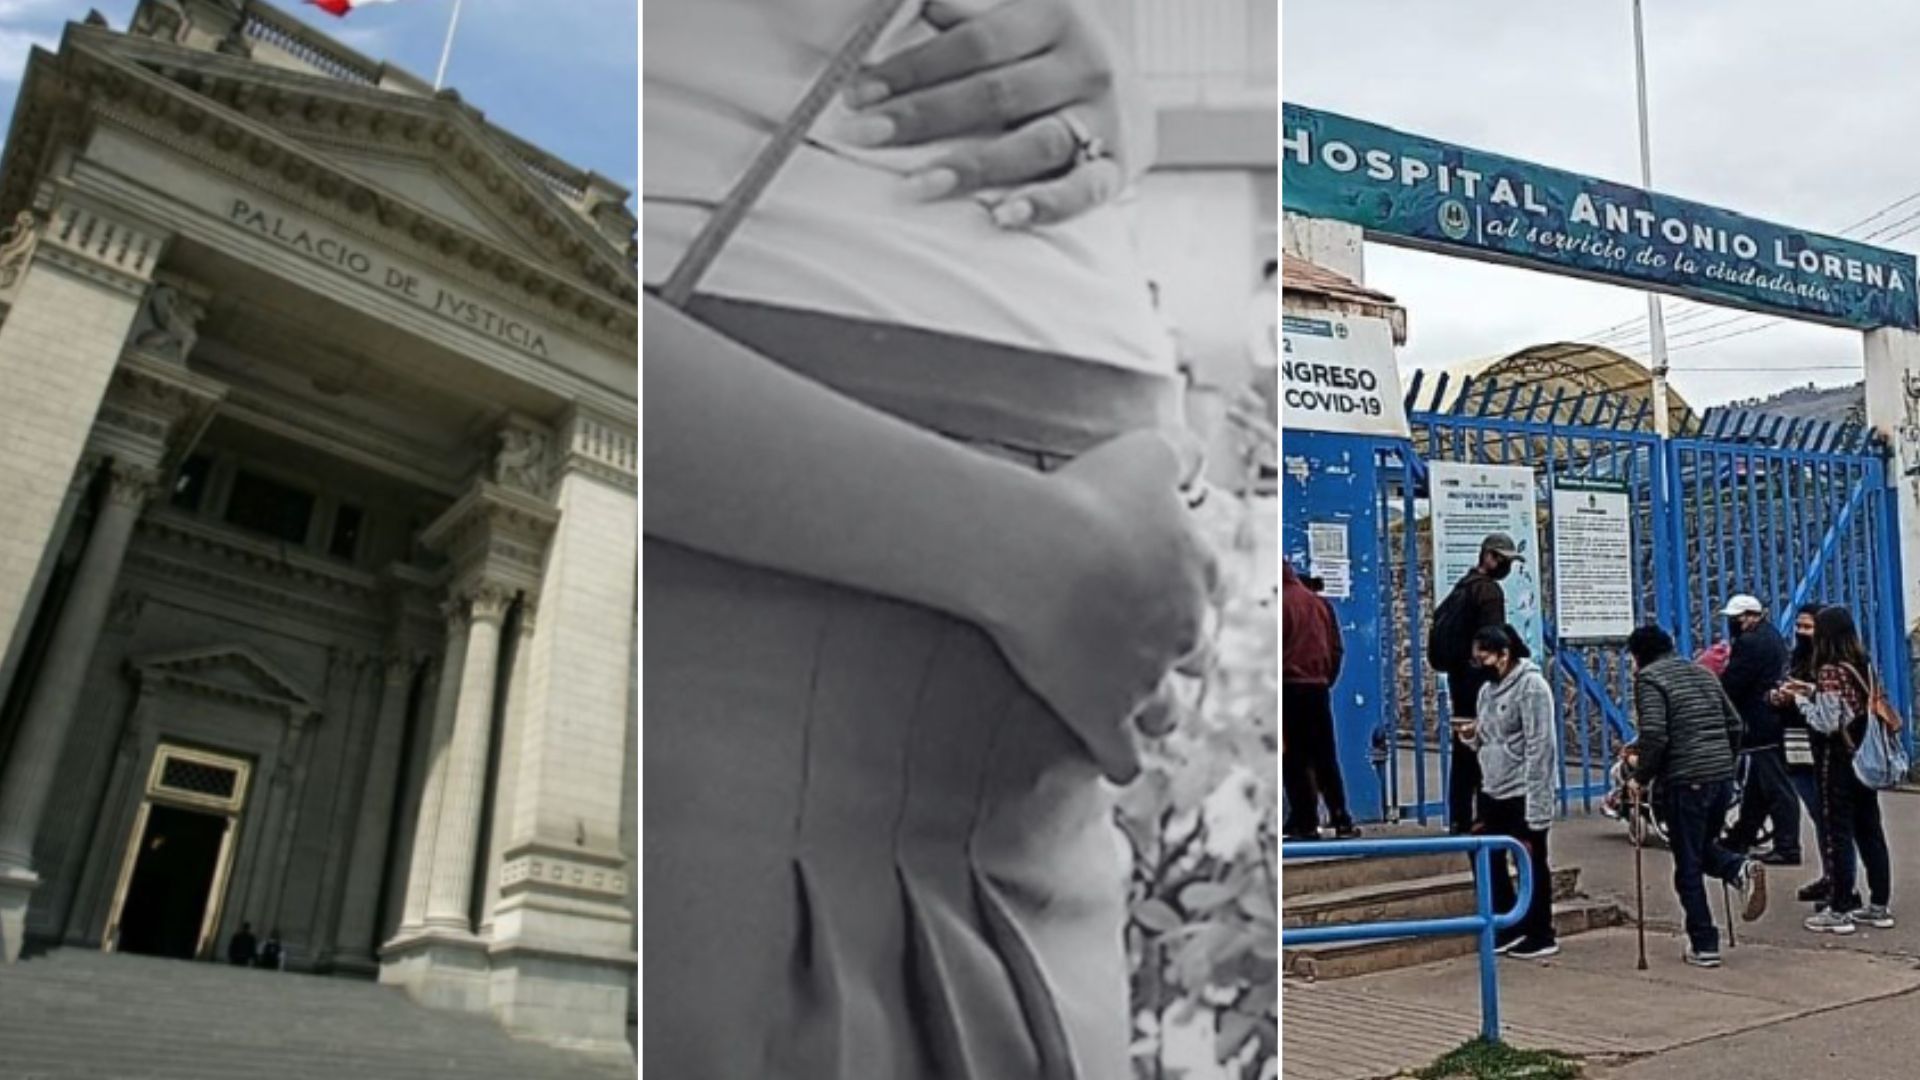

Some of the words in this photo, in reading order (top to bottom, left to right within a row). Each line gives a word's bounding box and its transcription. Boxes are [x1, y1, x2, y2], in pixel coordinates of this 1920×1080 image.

[231, 200, 370, 274] PALACIO
[384, 270, 420, 296] DE
[1282, 127, 1548, 216] HOSPITAL
[1569, 192, 1758, 260] ANTONIO
[1775, 238, 1905, 292] LORENA
[1486, 216, 1519, 238] al
[1526, 221, 1625, 261] servicio
[1636, 244, 1667, 268] de
[1673, 251, 1699, 275] la
[1285, 388, 1381, 416] COVID-19
